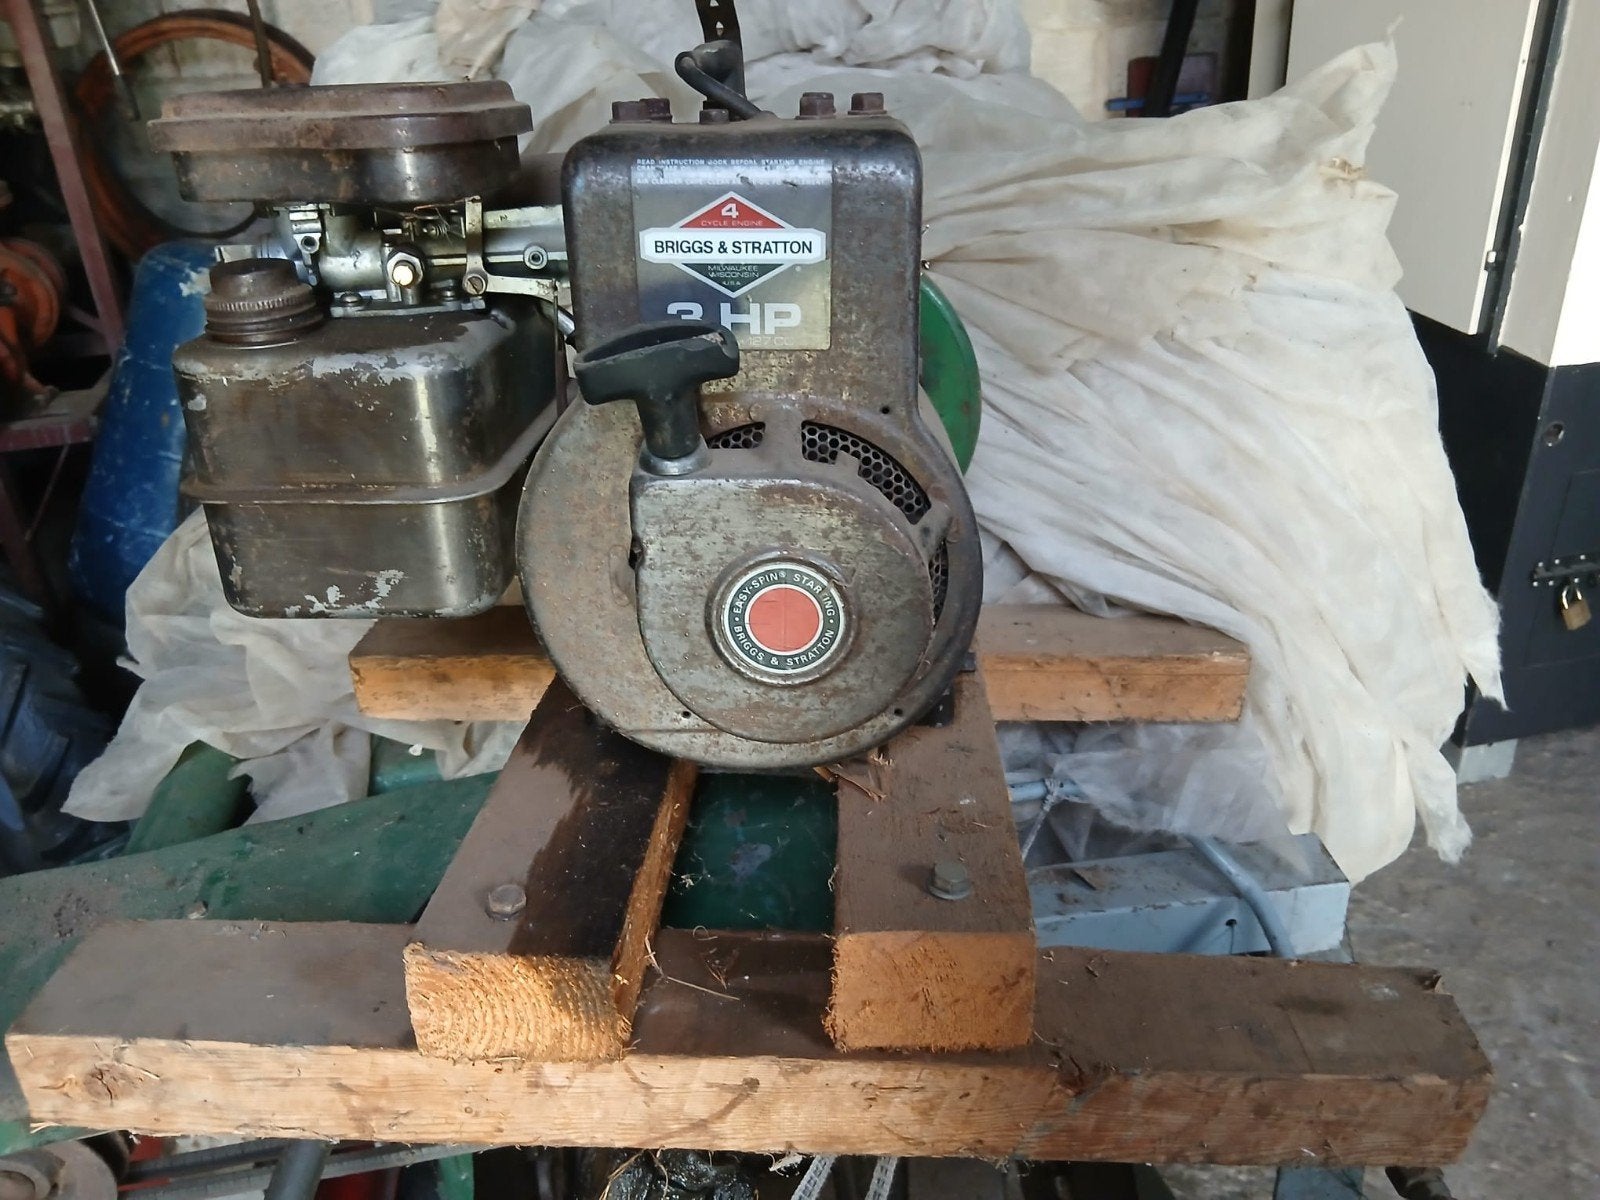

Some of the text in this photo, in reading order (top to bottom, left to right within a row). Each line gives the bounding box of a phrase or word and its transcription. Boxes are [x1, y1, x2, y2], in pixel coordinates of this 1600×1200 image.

[721, 203, 739, 219] 4
[654, 240, 813, 254] BRIGGS & STRATTON
[666, 302, 801, 335] 3 HP
[793, 573, 836, 616] STARING
[733, 625, 835, 666] BRIGGS & STRATTON
